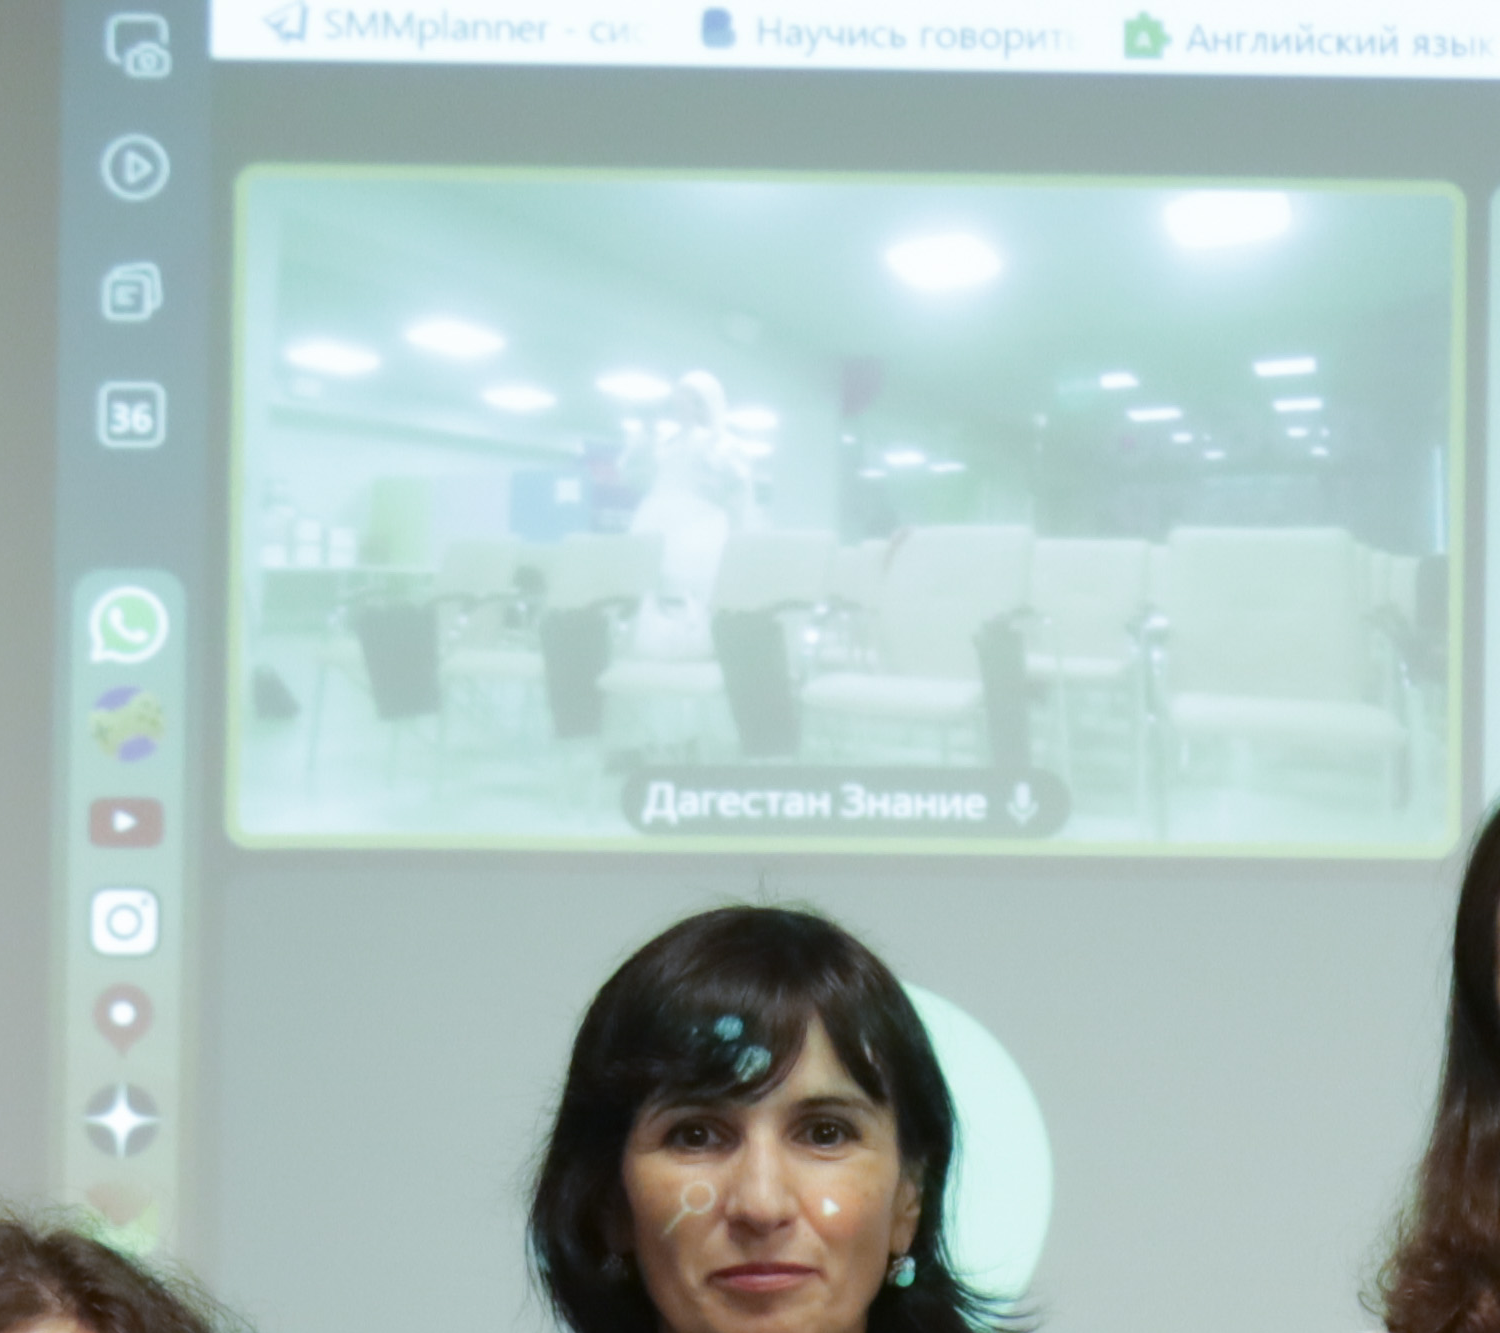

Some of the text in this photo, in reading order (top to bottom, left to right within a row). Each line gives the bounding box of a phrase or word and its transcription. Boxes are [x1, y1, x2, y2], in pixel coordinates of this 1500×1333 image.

[323, 8, 549, 50] SMMplanner
[756, 16, 907, 56] Научись
[1185, 23, 1400, 58] Английский
[109, 402, 154, 435] 36
[640, 780, 988, 825] Дагестан Знание
